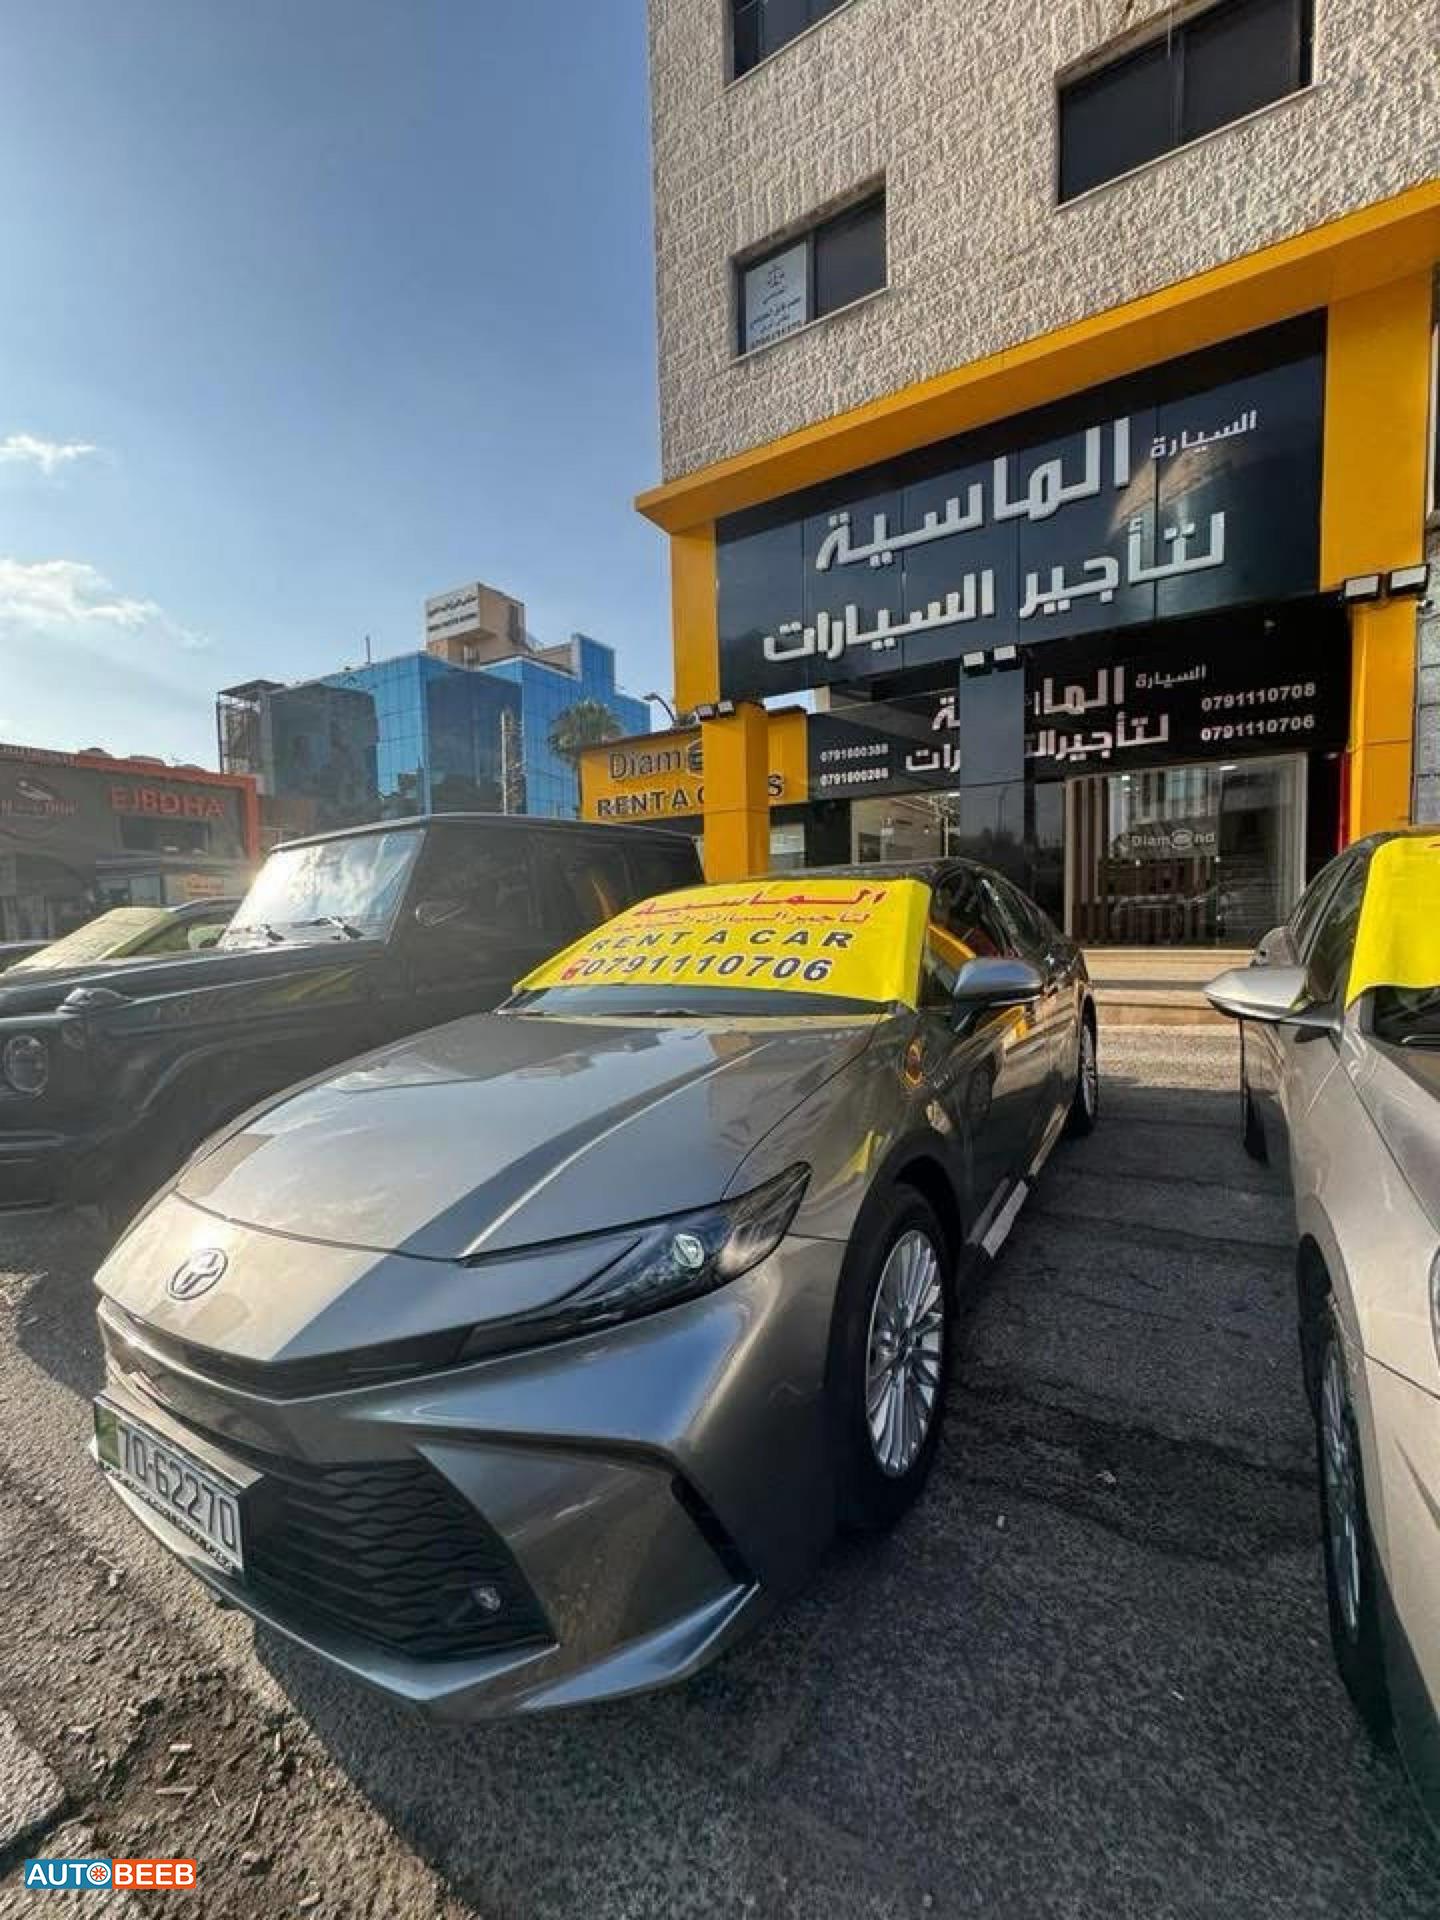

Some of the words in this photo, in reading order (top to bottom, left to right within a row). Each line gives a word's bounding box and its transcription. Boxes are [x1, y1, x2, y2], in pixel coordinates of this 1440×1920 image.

[1150, 410, 1258, 459] السيارة
[815, 417, 1131, 571] الماسية
[1018, 511, 1226, 620] لتأجير
[763, 568, 995, 661] السيارات
[1135, 664, 1207, 689] السيارة
[1201, 681, 1316, 712] 0791110708
[1055, 711, 1169, 761] لتأجير
[597, 790, 665, 817] RENT
[671, 782, 689, 808] A
[589, 930, 694, 952] RENT
[703, 929, 728, 945] A
[749, 929, 853, 948] CAR
[580, 954, 833, 982] 0791110706
